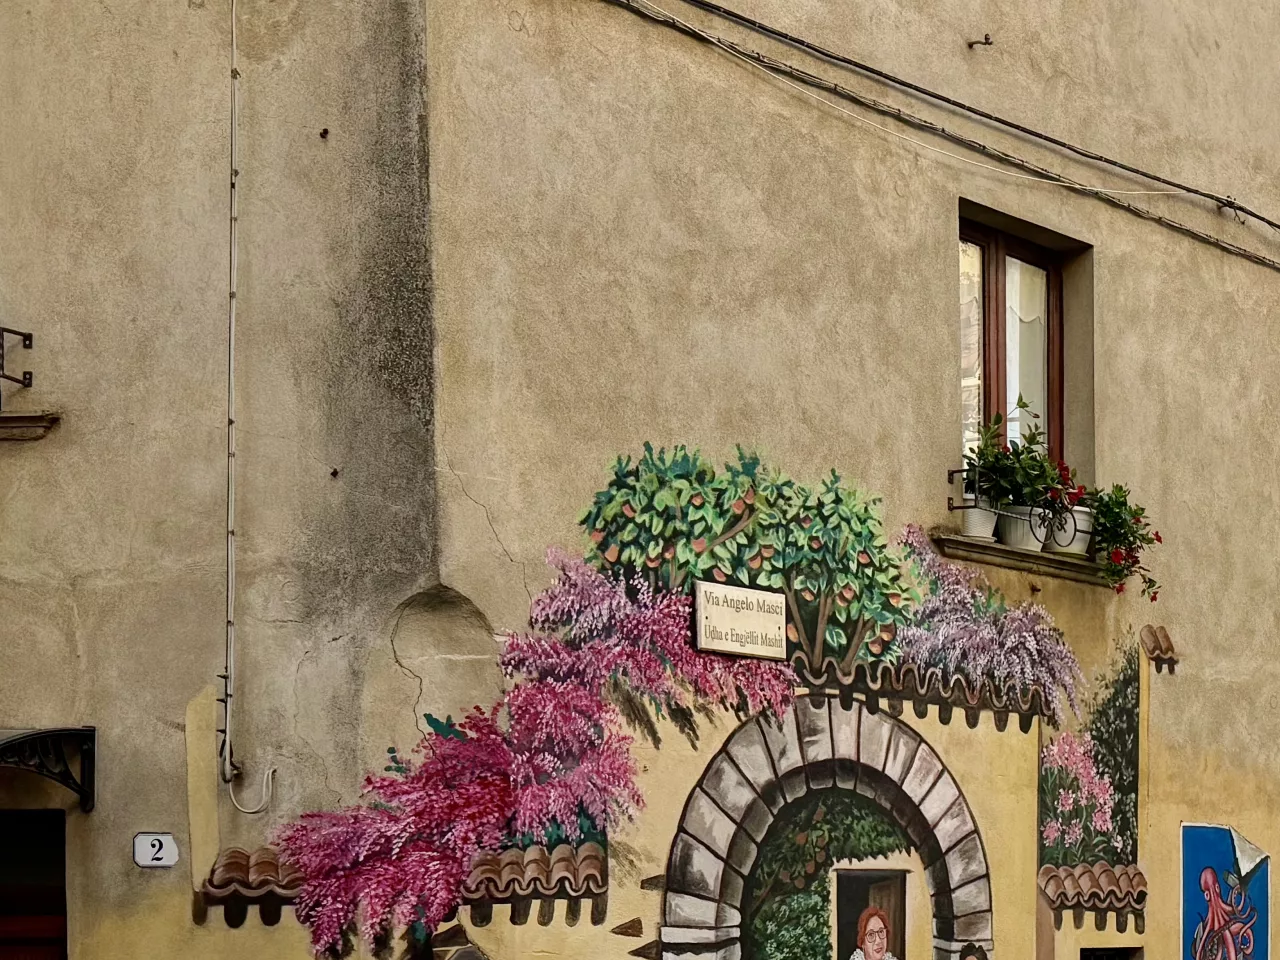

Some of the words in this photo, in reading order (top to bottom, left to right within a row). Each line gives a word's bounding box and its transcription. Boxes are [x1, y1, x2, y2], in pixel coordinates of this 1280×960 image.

[704, 590, 720, 606] Via
[721, 594, 754, 613] Angelo
[756, 598, 783, 616] Masci
[704, 624, 723, 642] Udha
[724, 631, 729, 642] e
[150, 838, 164, 862] 2
